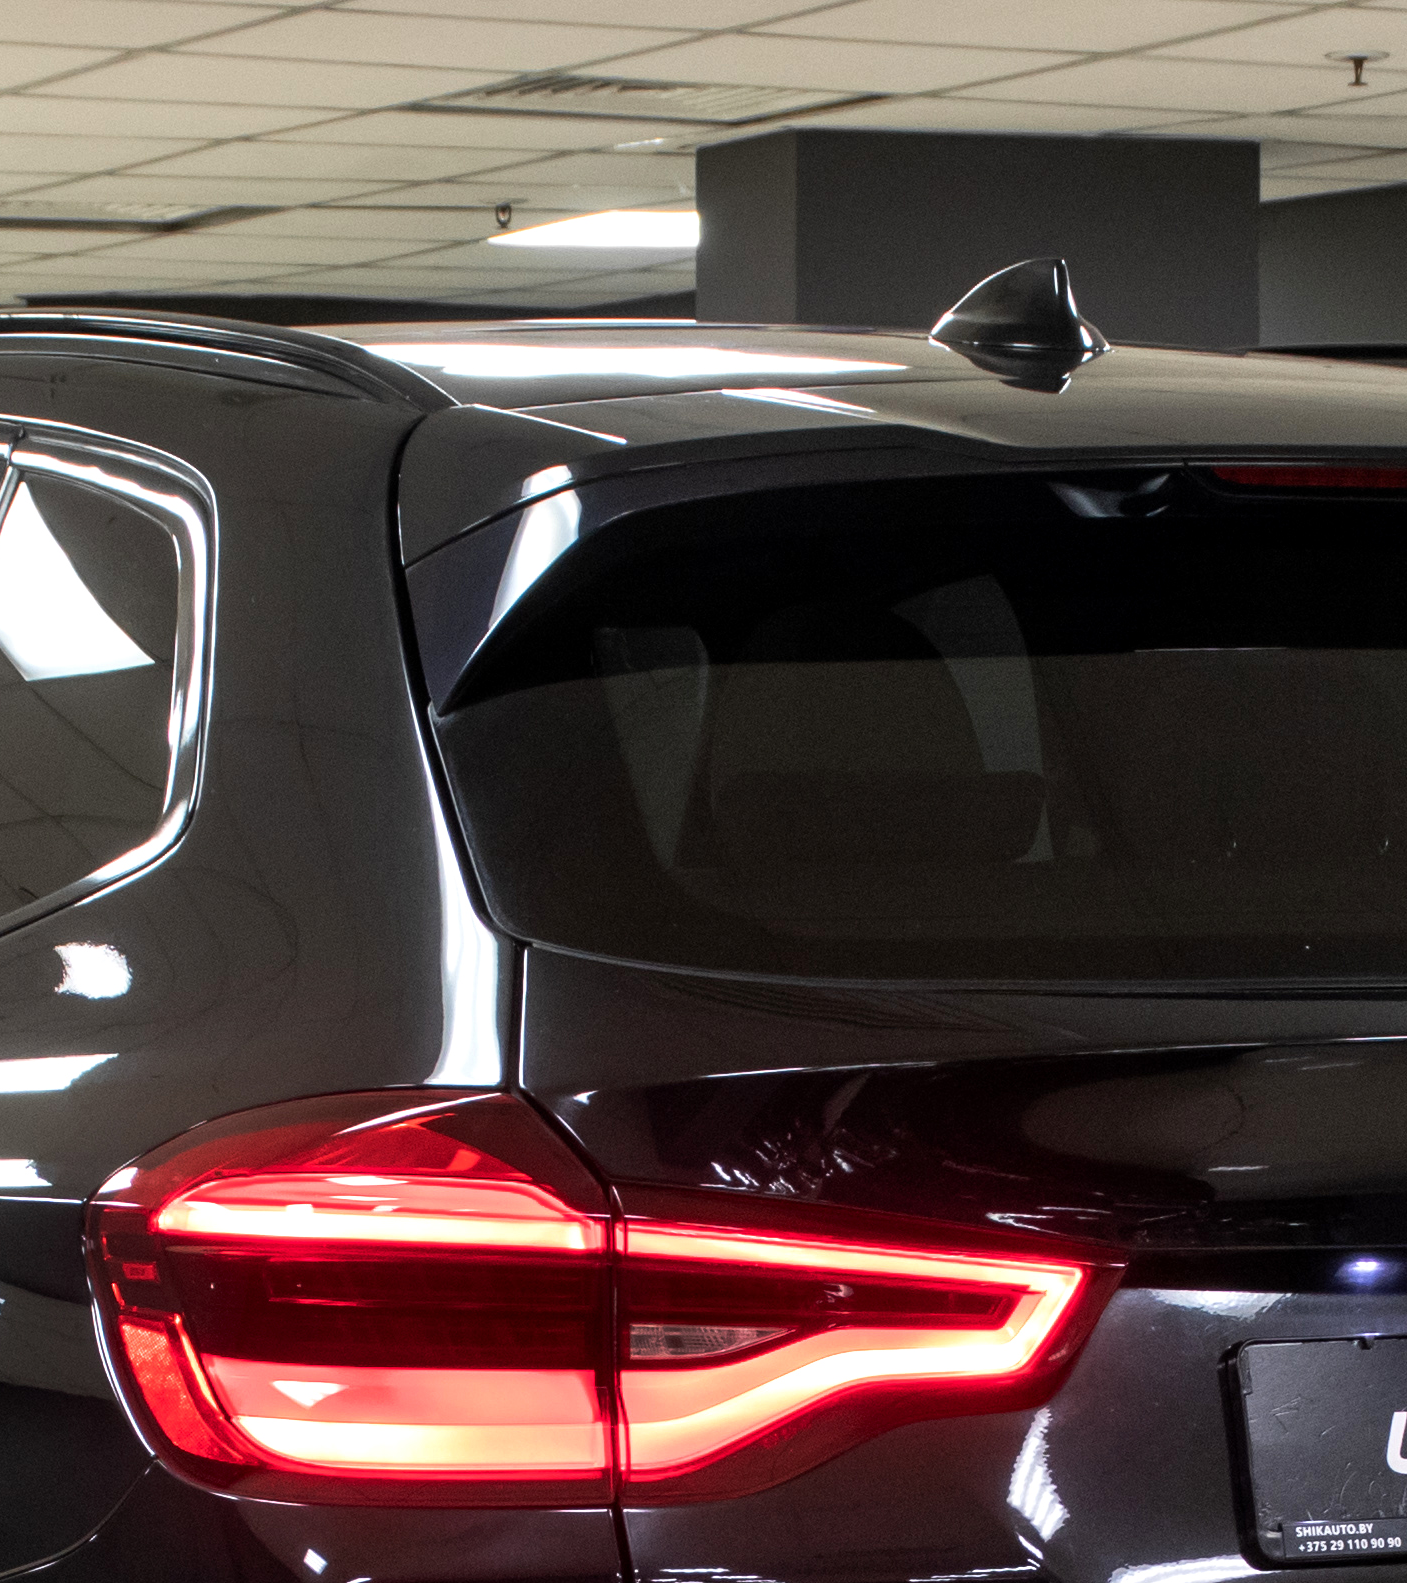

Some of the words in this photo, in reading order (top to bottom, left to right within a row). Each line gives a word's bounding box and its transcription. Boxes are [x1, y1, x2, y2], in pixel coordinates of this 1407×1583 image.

[1295, 1523, 1374, 1538] SHIKAUTO.BY
[1298, 1541, 1328, 1552] +375
[1330, 1539, 1344, 1551] 29
[1347, 1538, 1368, 1550] 110
[1370, 1537, 1385, 1549] 90
[1387, 1536, 1402, 1548] 90
